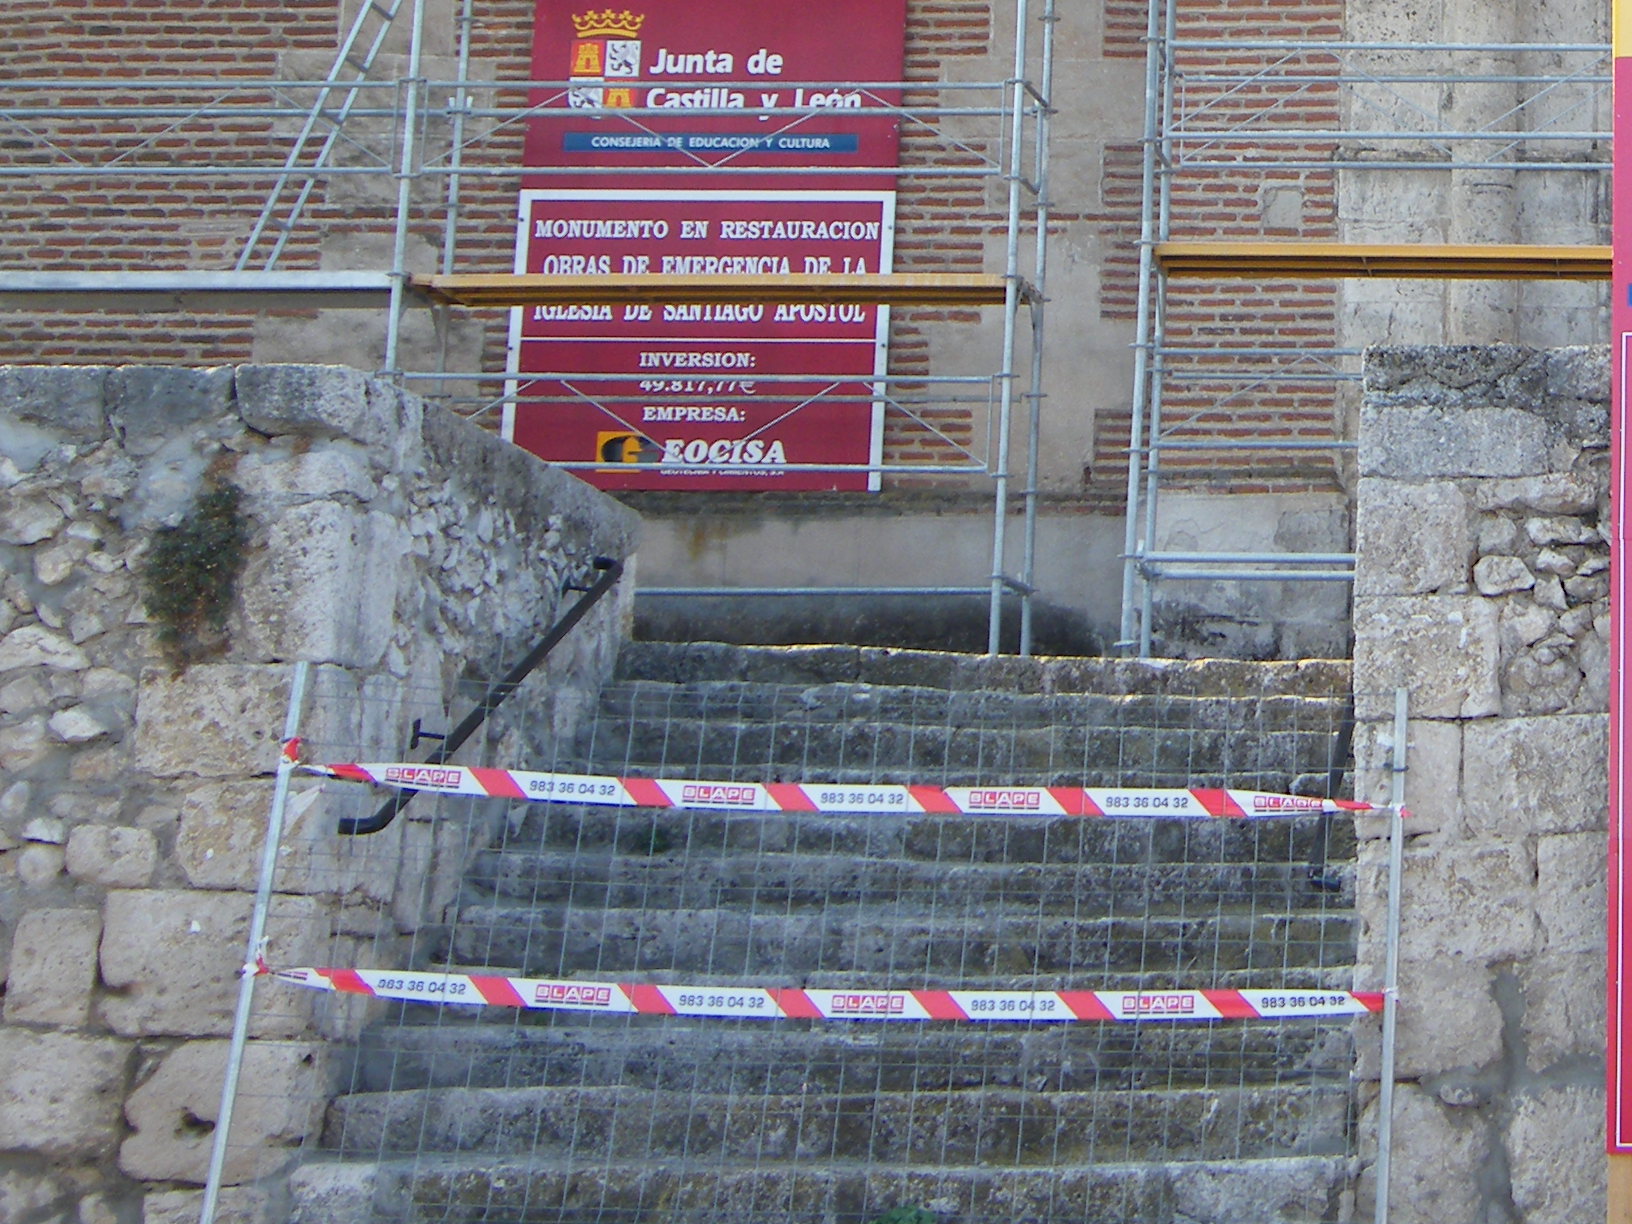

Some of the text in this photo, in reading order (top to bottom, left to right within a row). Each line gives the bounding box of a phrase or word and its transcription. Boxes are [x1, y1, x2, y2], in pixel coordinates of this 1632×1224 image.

[649, 48, 784, 75] Junta de
[645, 87, 745, 108] Castilla
[759, 93, 779, 120] y
[591, 136, 831, 150] CONSEJERIA DE EDUCACION Y CULTURA
[534, 219, 880, 240] MONUMENTO EN RESTAURACION
[542, 253, 868, 273] OBRAS DE EMERGENCIA DE LA
[623, 305, 652, 322] DE
[639, 352, 756, 368] INVERSION:
[642, 406, 746, 422] EMPRESA:
[529, 780, 554, 793] 983
[559, 781, 574, 794] 36
[579, 782, 595, 795] 04
[600, 783, 616, 796] 32
[820, 792, 844, 804] 983
[849, 792, 863, 804] 36
[868, 793, 884, 805] 04
[888, 793, 904, 805] 32
[1106, 796, 1129, 808] 983
[1134, 796, 1149, 808] 36
[1153, 796, 1169, 808] 04
[1173, 797, 1188, 809] 32
[449, 983, 466, 994] 32
[679, 994, 703, 1006] 983
[707, 995, 723, 1007] 36
[727, 995, 744, 1007] 04
[748, 996, 765, 1008] 32
[971, 999, 995, 1011] 983
[999, 999, 1015, 1011] 36
[1019, 999, 1036, 1011] 04
[1040, 999, 1056, 1011] 32
[1262, 997, 1286, 1008] 983
[1290, 996, 1306, 1008] 36
[1310, 996, 1326, 1007] 04
[1330, 995, 1345, 1006] 32
